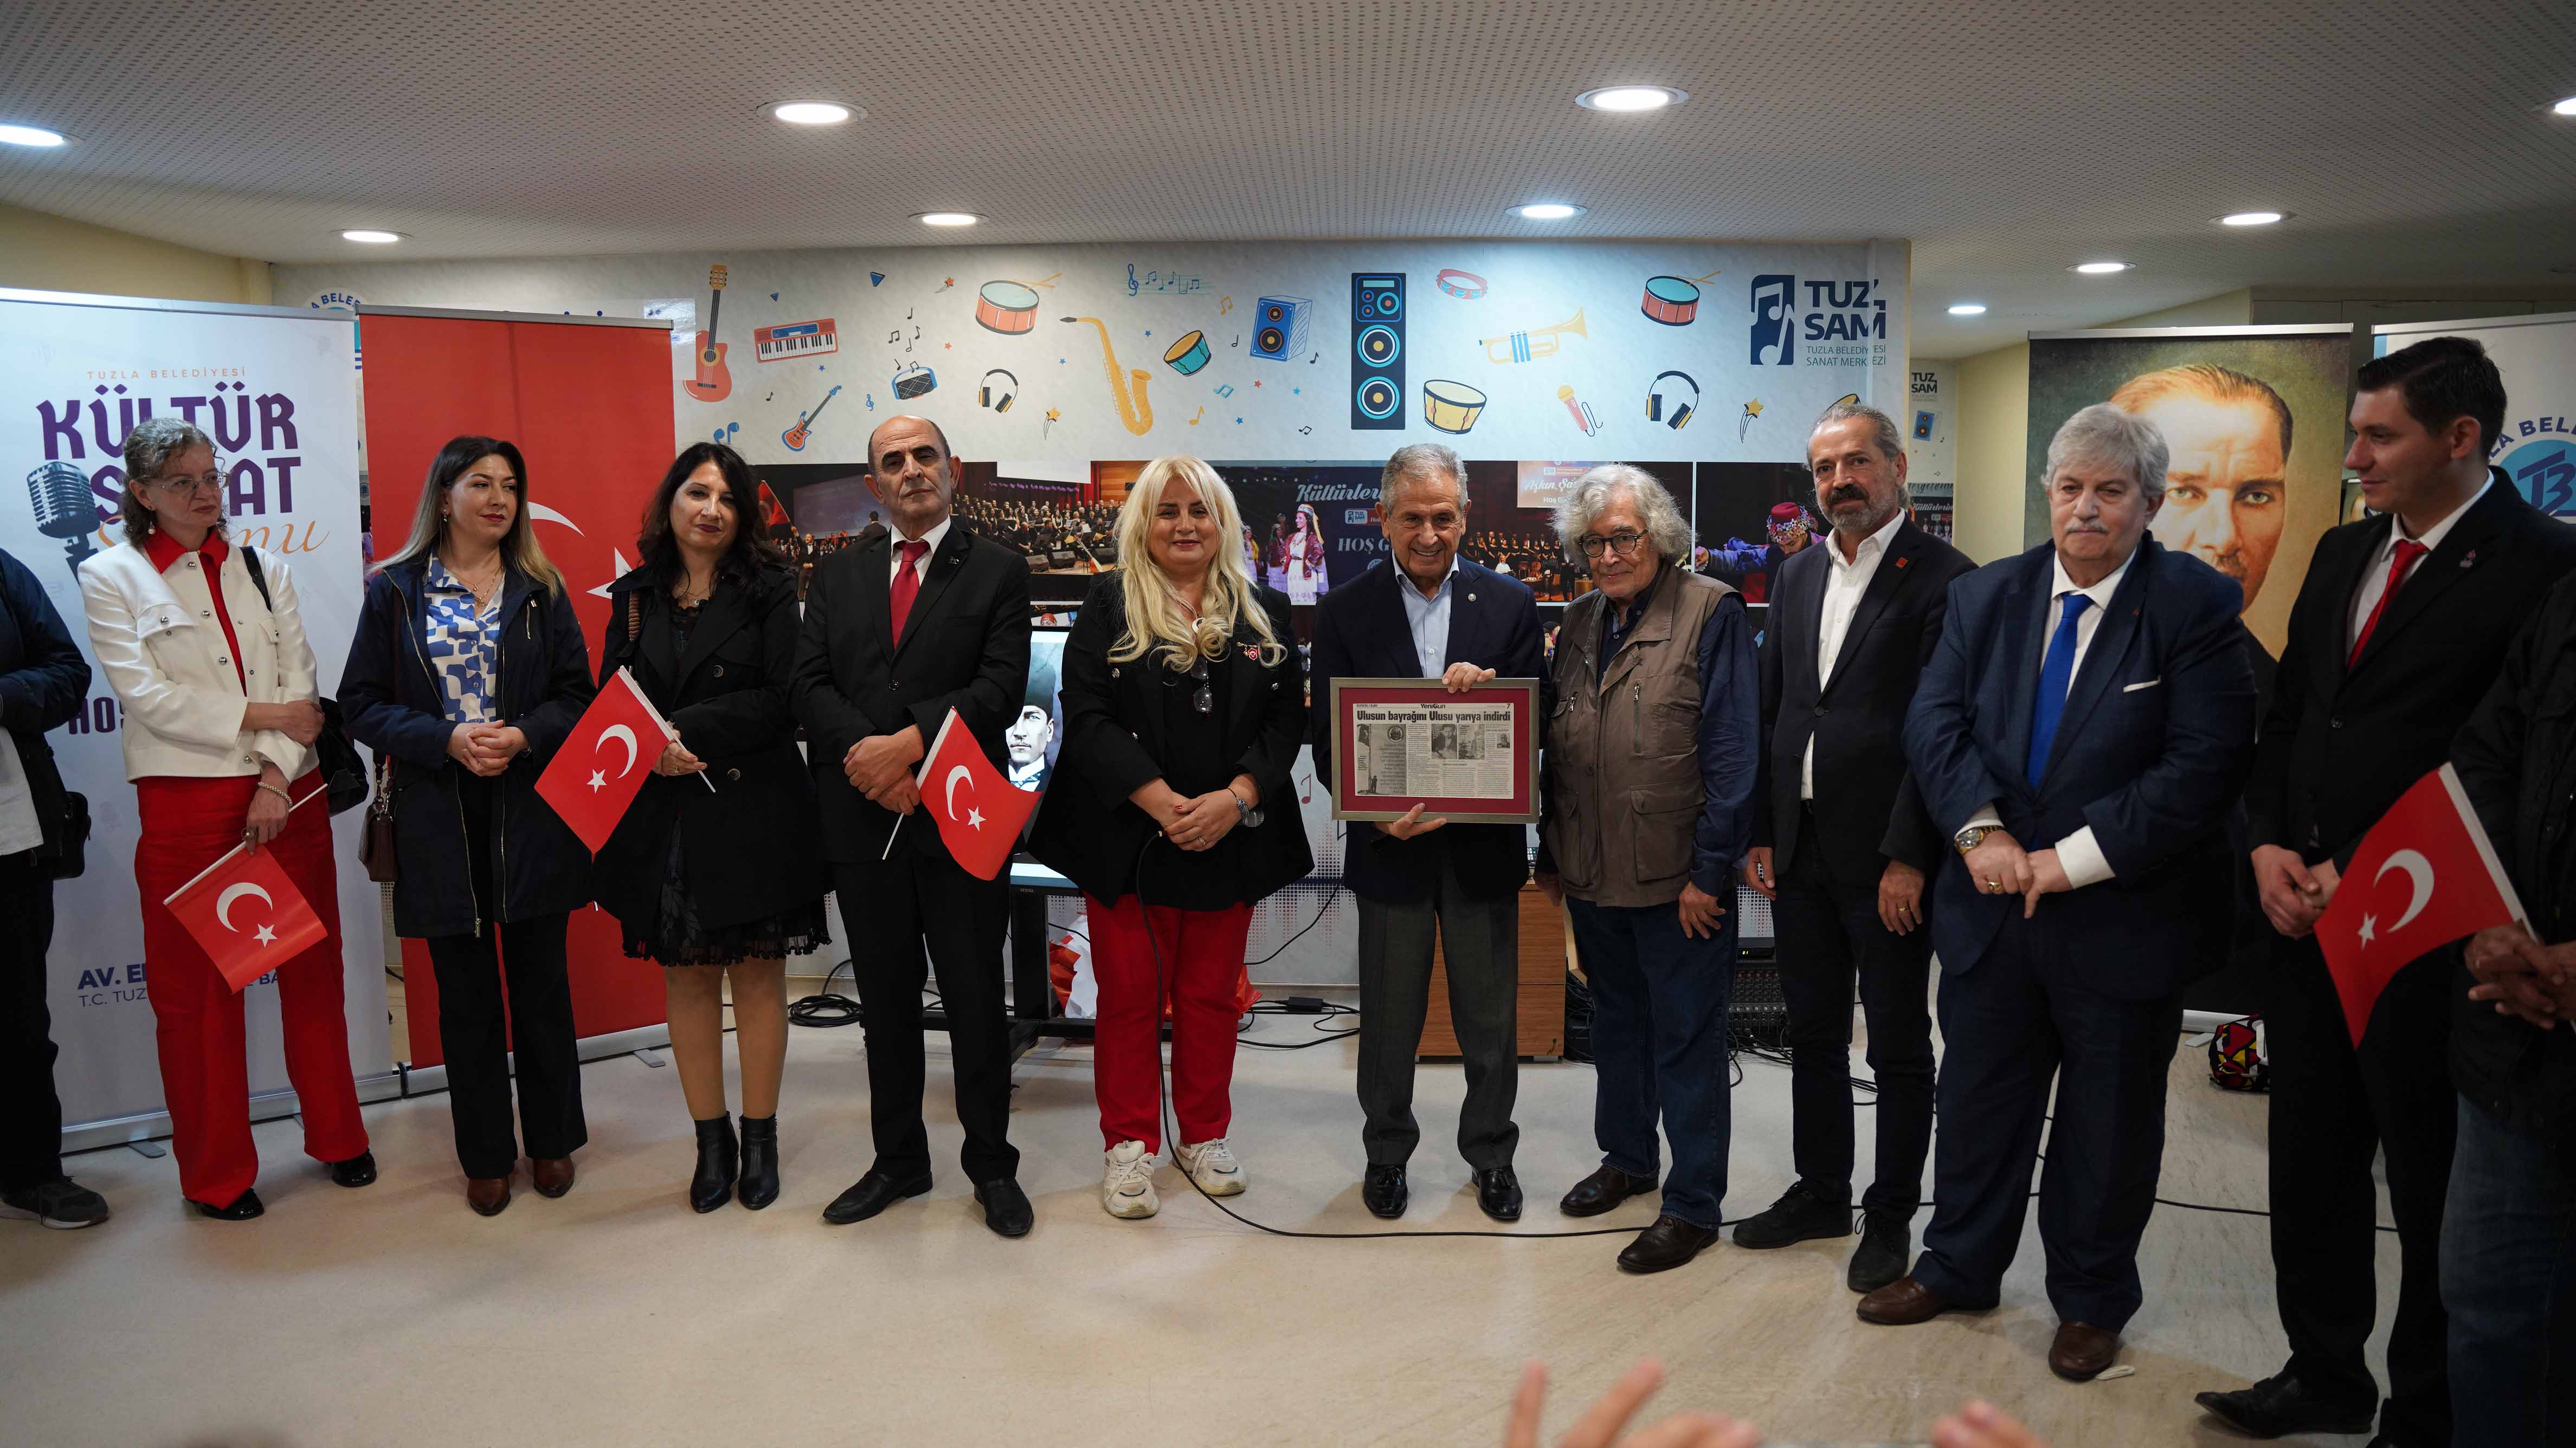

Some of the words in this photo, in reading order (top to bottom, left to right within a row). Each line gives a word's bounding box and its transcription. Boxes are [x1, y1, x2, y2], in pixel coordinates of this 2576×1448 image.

[321, 293, 360, 305] BELE
[1804, 279, 1886, 311] TUZ
[1804, 312, 1886, 341] SAM
[1807, 345, 1834, 354] TUZLA
[1836, 344, 1886, 355] BELEDİYESİ
[1806, 357, 1839, 366] SANAT
[1840, 355, 1886, 367] MERKEZİ
[87, 370, 139, 380] TUZLA
[150, 366, 246, 378] BELEDİYESİ
[1911, 372, 1937, 382] TUZ
[1911, 383, 1937, 393] SAM
[1338, 538, 1374, 554] HOŞ
[1357, 710, 1386, 720] Ulusun
[1388, 710, 1427, 723] bayrağını
[1429, 710, 1453, 721] Ulusu
[1456, 712, 1481, 723] yarıya
[1483, 711, 1511, 721] indirdi
[78, 966, 121, 990] AV.
[78, 993, 108, 1007] T.C.
[112, 987, 147, 1003] TUZ
